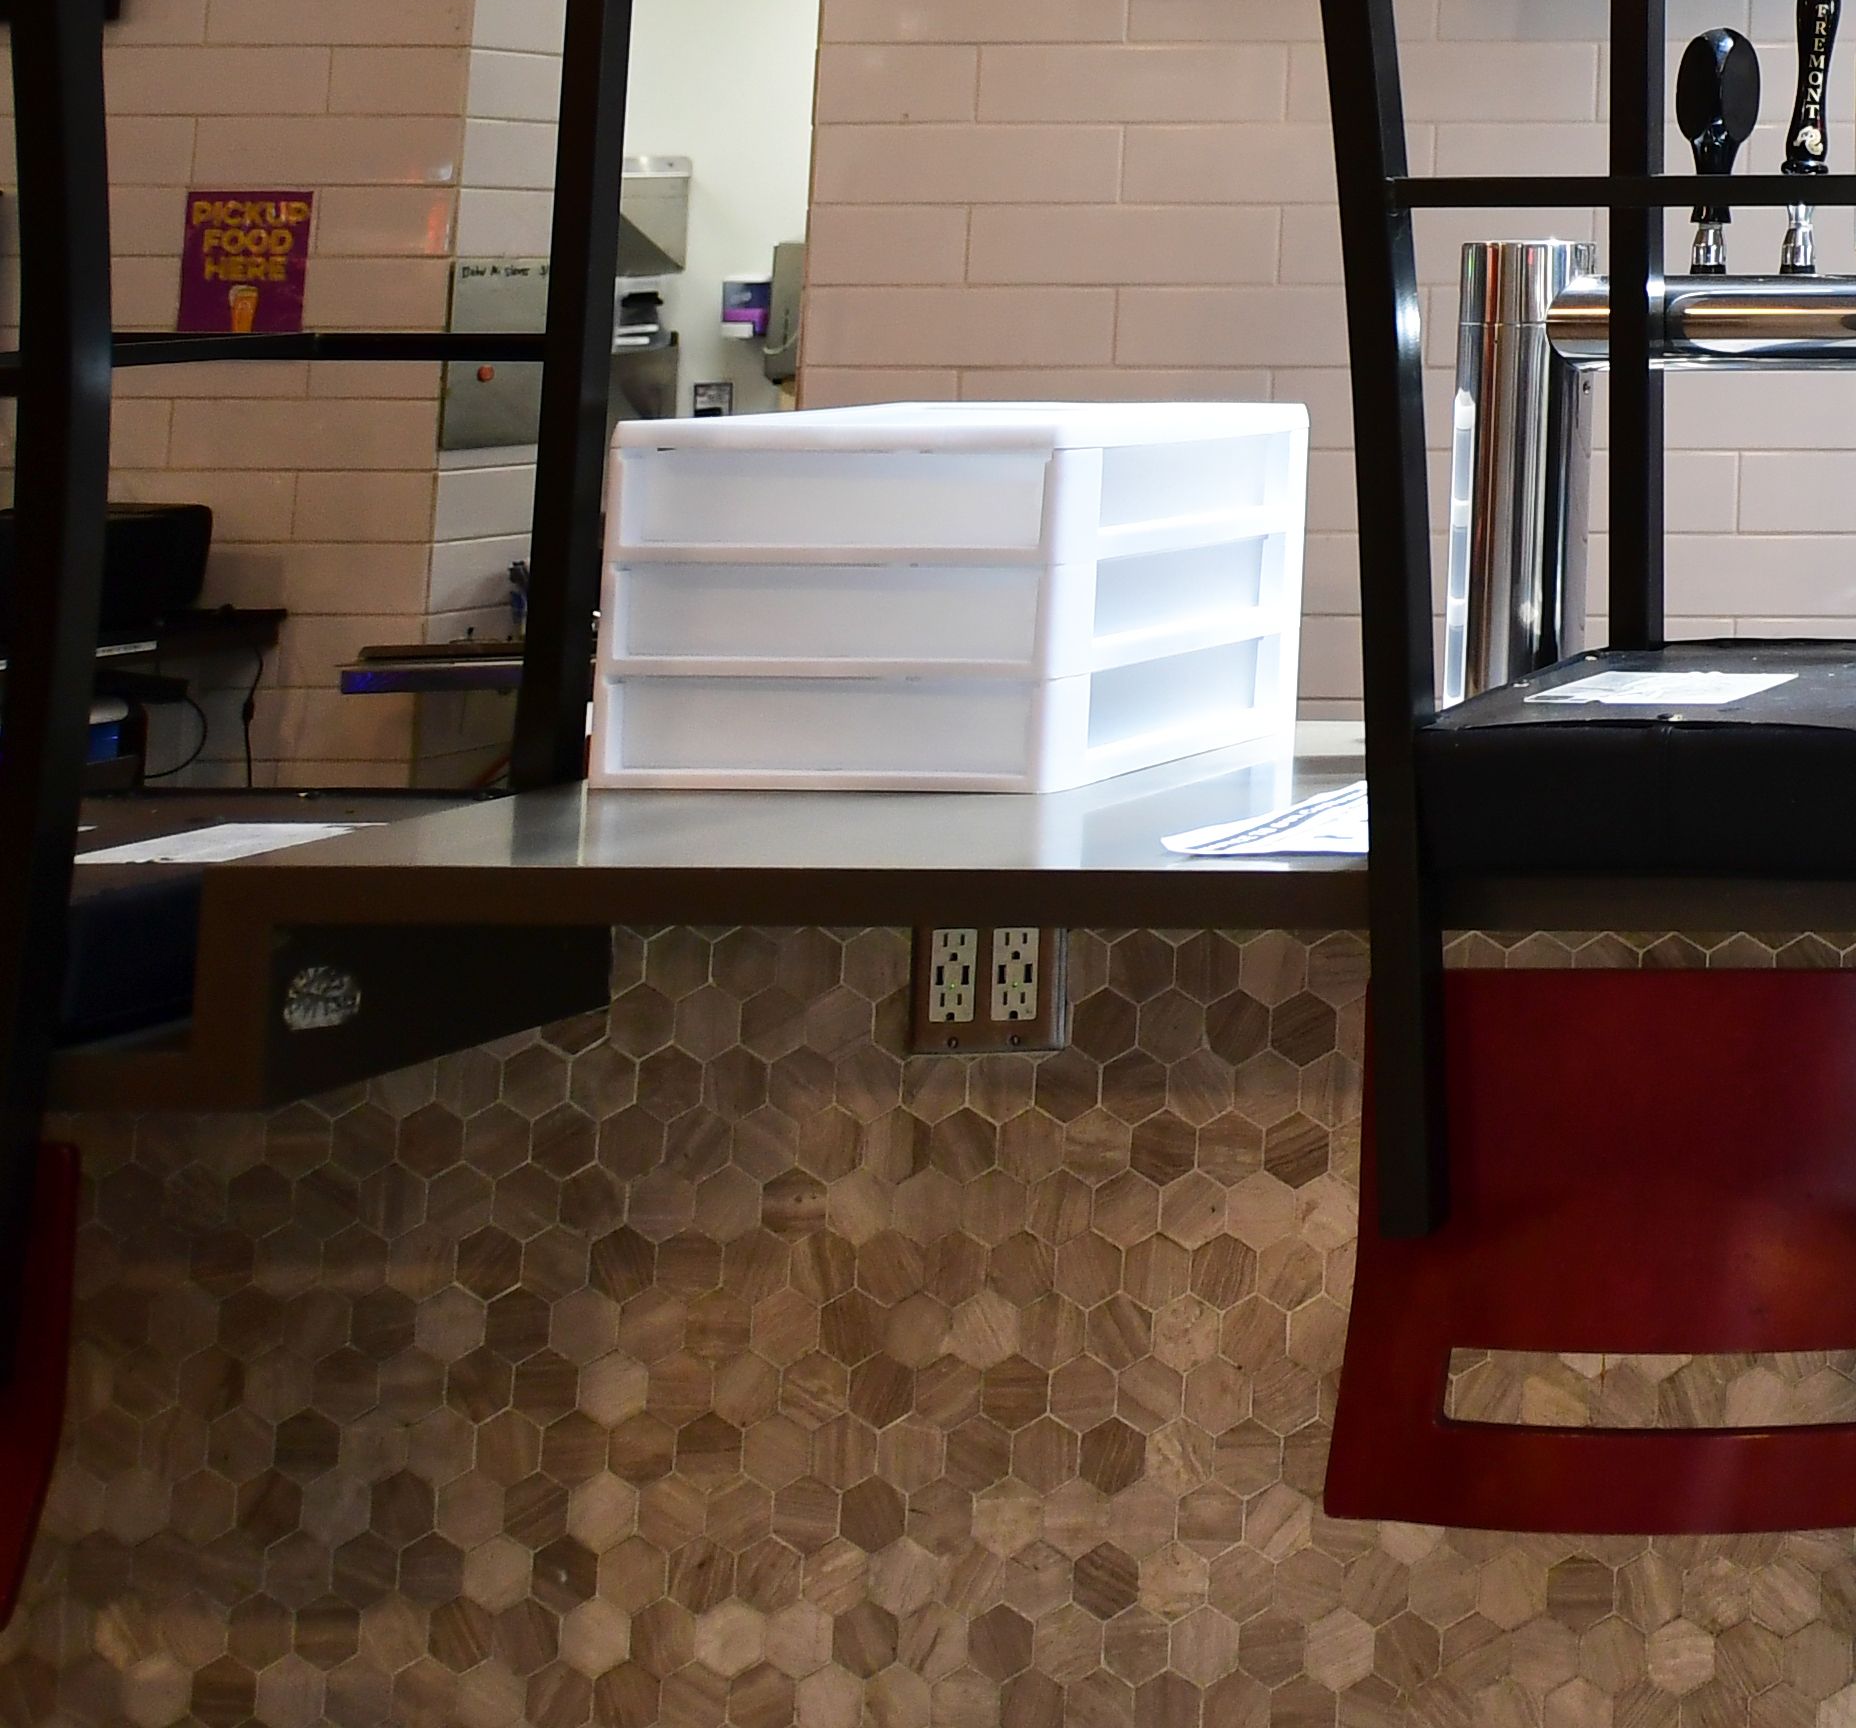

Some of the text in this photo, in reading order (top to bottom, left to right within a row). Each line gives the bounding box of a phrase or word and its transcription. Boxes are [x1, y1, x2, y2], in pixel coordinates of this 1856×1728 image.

[1805, 3, 1829, 119] FREMONT
[192, 200, 310, 226] PICKUP
[203, 228, 293, 254] FOOD
[204, 255, 288, 281] HERE
